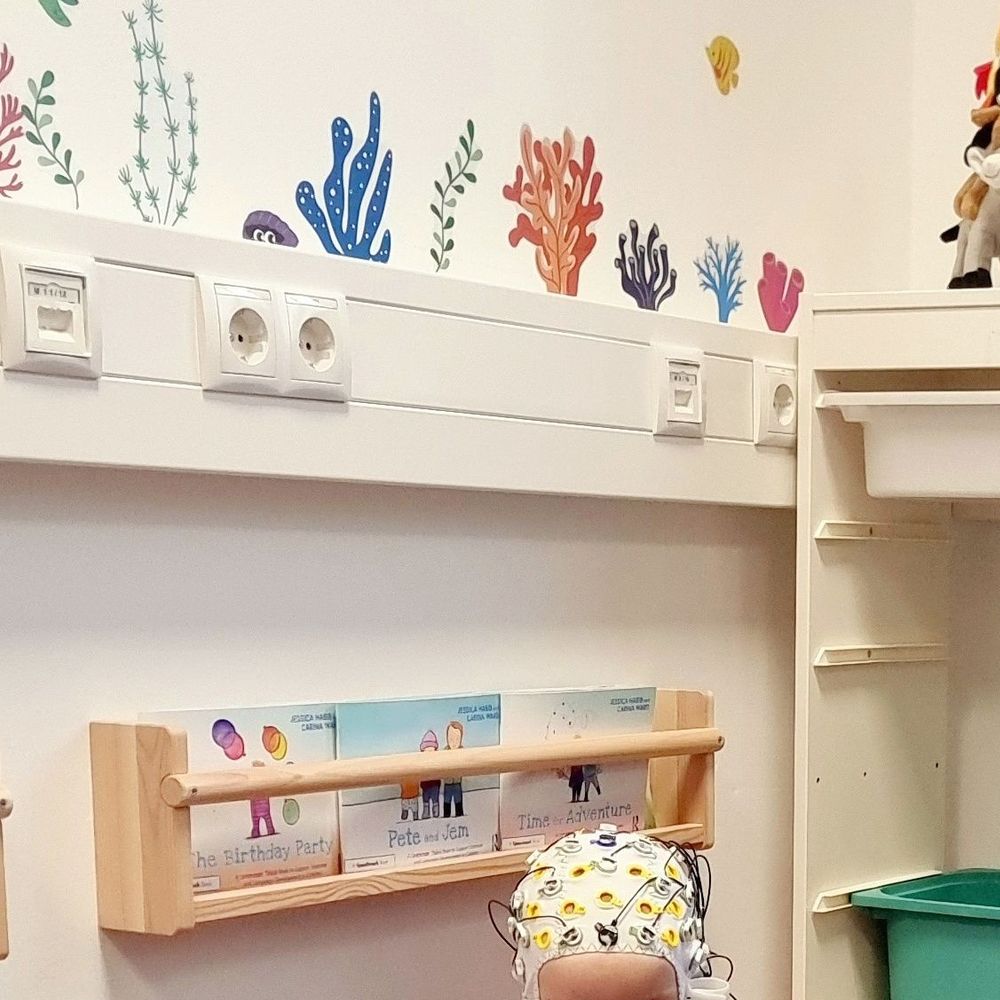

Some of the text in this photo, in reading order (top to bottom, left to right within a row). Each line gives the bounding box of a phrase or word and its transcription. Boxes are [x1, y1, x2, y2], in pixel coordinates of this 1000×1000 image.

[518, 814, 551, 831] Time
[565, 802, 633, 825] Adventure
[388, 827, 422, 849] Pete
[441, 823, 470, 841] Jem
[191, 836, 334, 869] he Birthday Party
